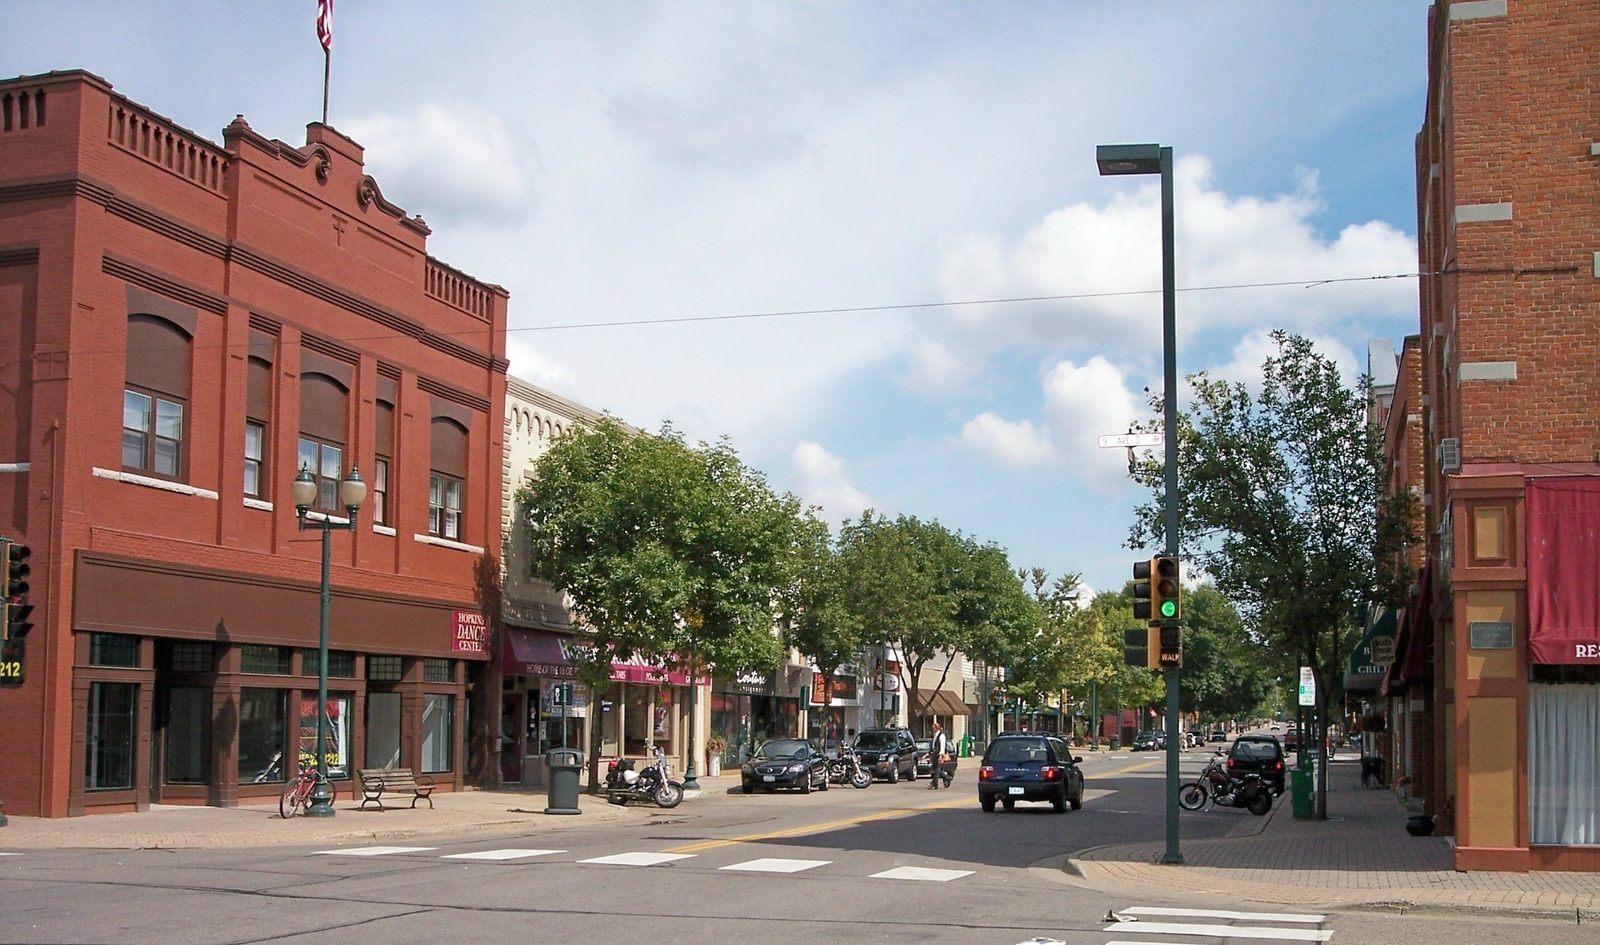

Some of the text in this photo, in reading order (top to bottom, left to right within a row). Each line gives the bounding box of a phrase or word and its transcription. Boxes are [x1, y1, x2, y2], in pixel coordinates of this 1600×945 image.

[1117, 436, 1130, 445] AVE
[458, 612, 485, 625] HOPKINS
[457, 624, 486, 641] DANCE
[459, 640, 483, 651] CENTER
[1161, 653, 1179, 662] WALK
[526, 663, 541, 674] HOME
